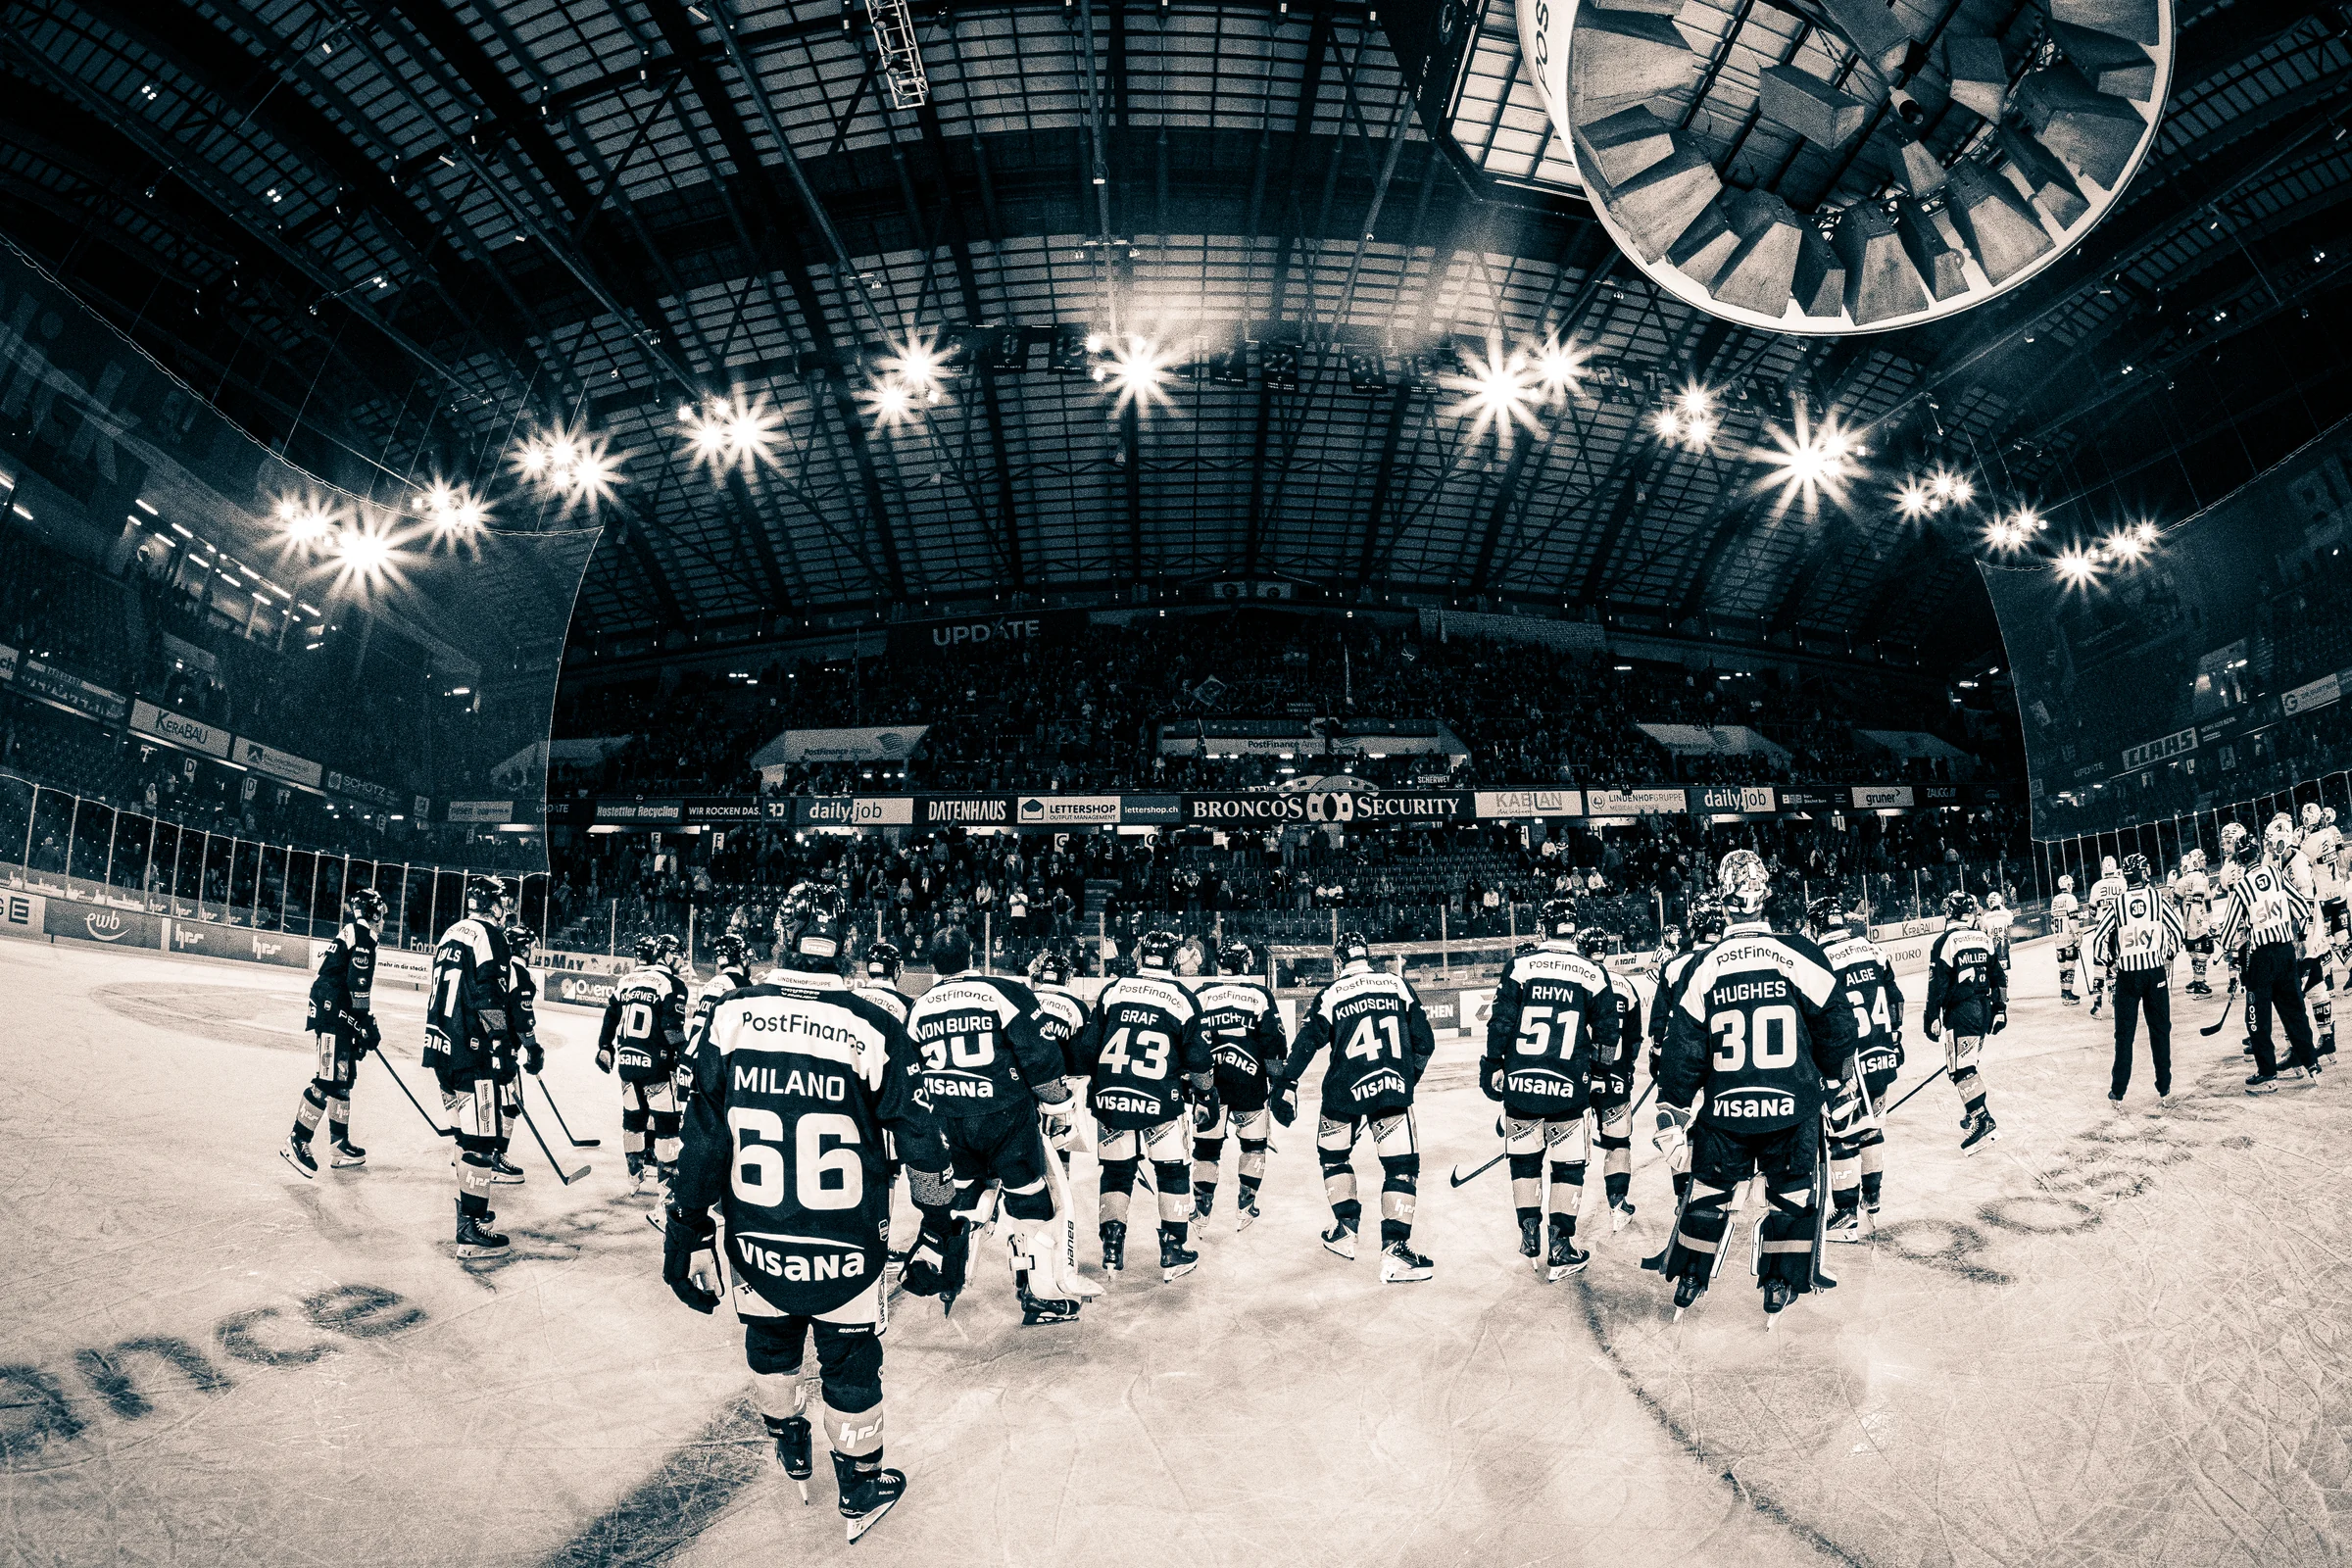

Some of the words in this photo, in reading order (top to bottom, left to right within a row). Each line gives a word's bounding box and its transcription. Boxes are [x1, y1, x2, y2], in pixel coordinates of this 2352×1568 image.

[1248, 740, 1298, 749] PostFinance
[2129, 731, 2193, 767] CLAAS
[1193, 797, 1303, 819] BRONCOS
[1356, 796, 1459, 818] SECURITY
[1609, 793, 1684, 803] LINDENHOFGRUPPE
[1866, 793, 1895, 806] gruner
[638, 806, 679, 818] Recycling
[688, 807, 704, 815] WIR
[706, 807, 740, 815] ROCKEN
[929, 801, 1005, 821] DATENHAUS
[1050, 804, 1116, 814] LETTERSHOP
[1124, 806, 1179, 815] lettershop.ch
[2257, 876, 2270, 889] 57
[2131, 902, 2145, 916] 36
[2255, 899, 2283, 924] sky
[2122, 926, 2155, 950] sky
[1716, 946, 1794, 970] PostFinance
[1529, 960, 1596, 981] PostFinance
[1845, 967, 1876, 987] ALGE
[777, 976, 832, 988] LINDENHOFGRUPPE
[1713, 980, 1787, 1005] HUGHES
[621, 991, 660, 1004] ERWEY
[862, 994, 899, 1015] Finance
[1532, 986, 1573, 1004] RHYN
[1120, 1009, 1159, 1026] GRAF
[1336, 998, 1398, 1021] KINDSCHI
[742, 1010, 866, 1055] PostFinance
[916, 1021, 944, 1041] VON
[947, 1016, 993, 1032] BURG
[1346, 1015, 1402, 1061] 41
[1516, 1006, 1579, 1060] 51
[1710, 1004, 1797, 1072] 30
[1099, 1027, 1170, 1080] 43
[734, 1065, 846, 1102] MILANO
[727, 1106, 863, 1210] 66
